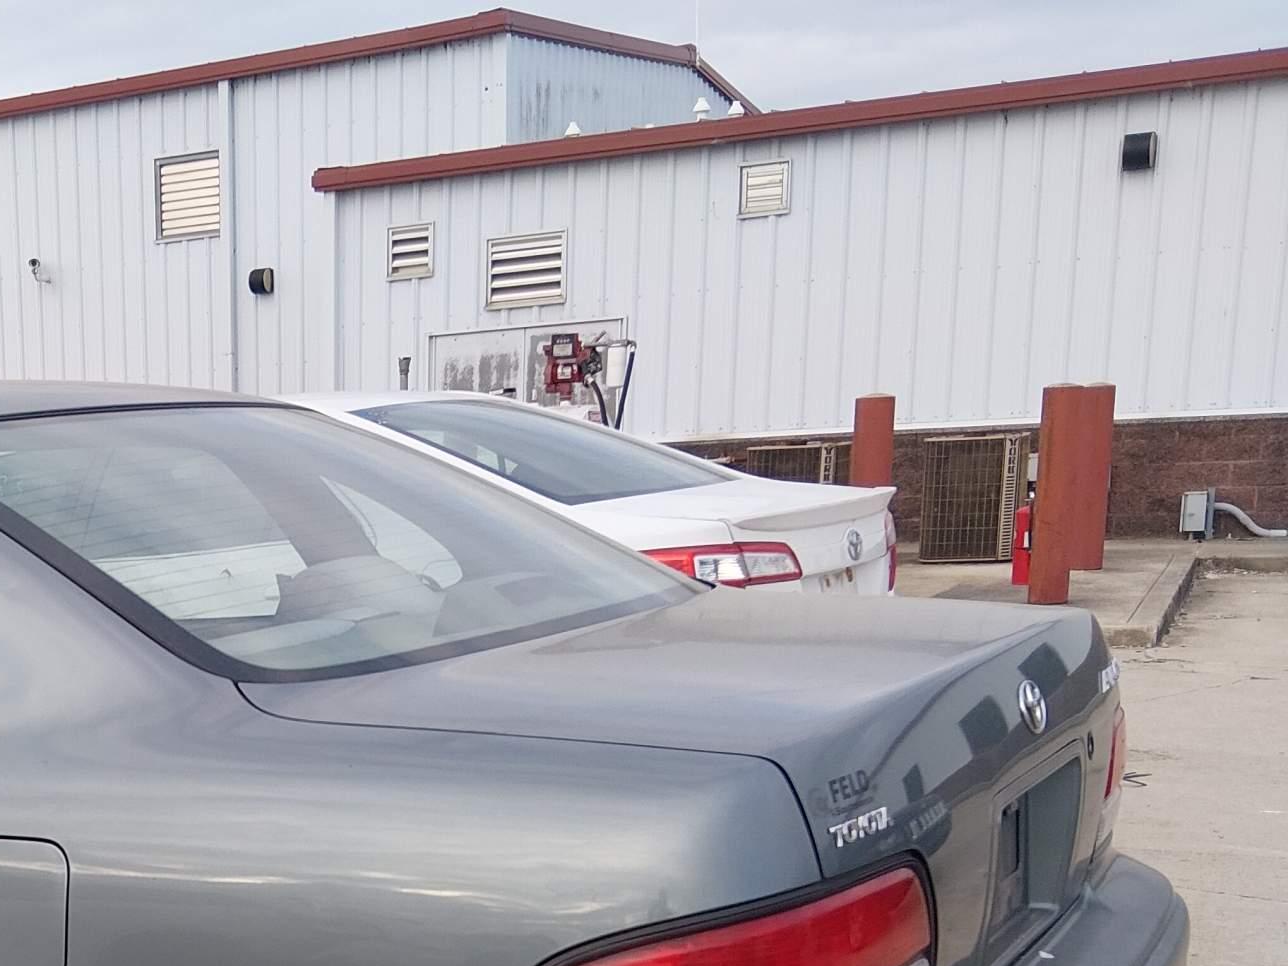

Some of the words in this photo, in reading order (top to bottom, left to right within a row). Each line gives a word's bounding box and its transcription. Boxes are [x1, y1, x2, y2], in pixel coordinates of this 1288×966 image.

[823, 447, 833, 482] YORK
[1007, 438, 1018, 474] YORK
[828, 769, 870, 803] FELD
